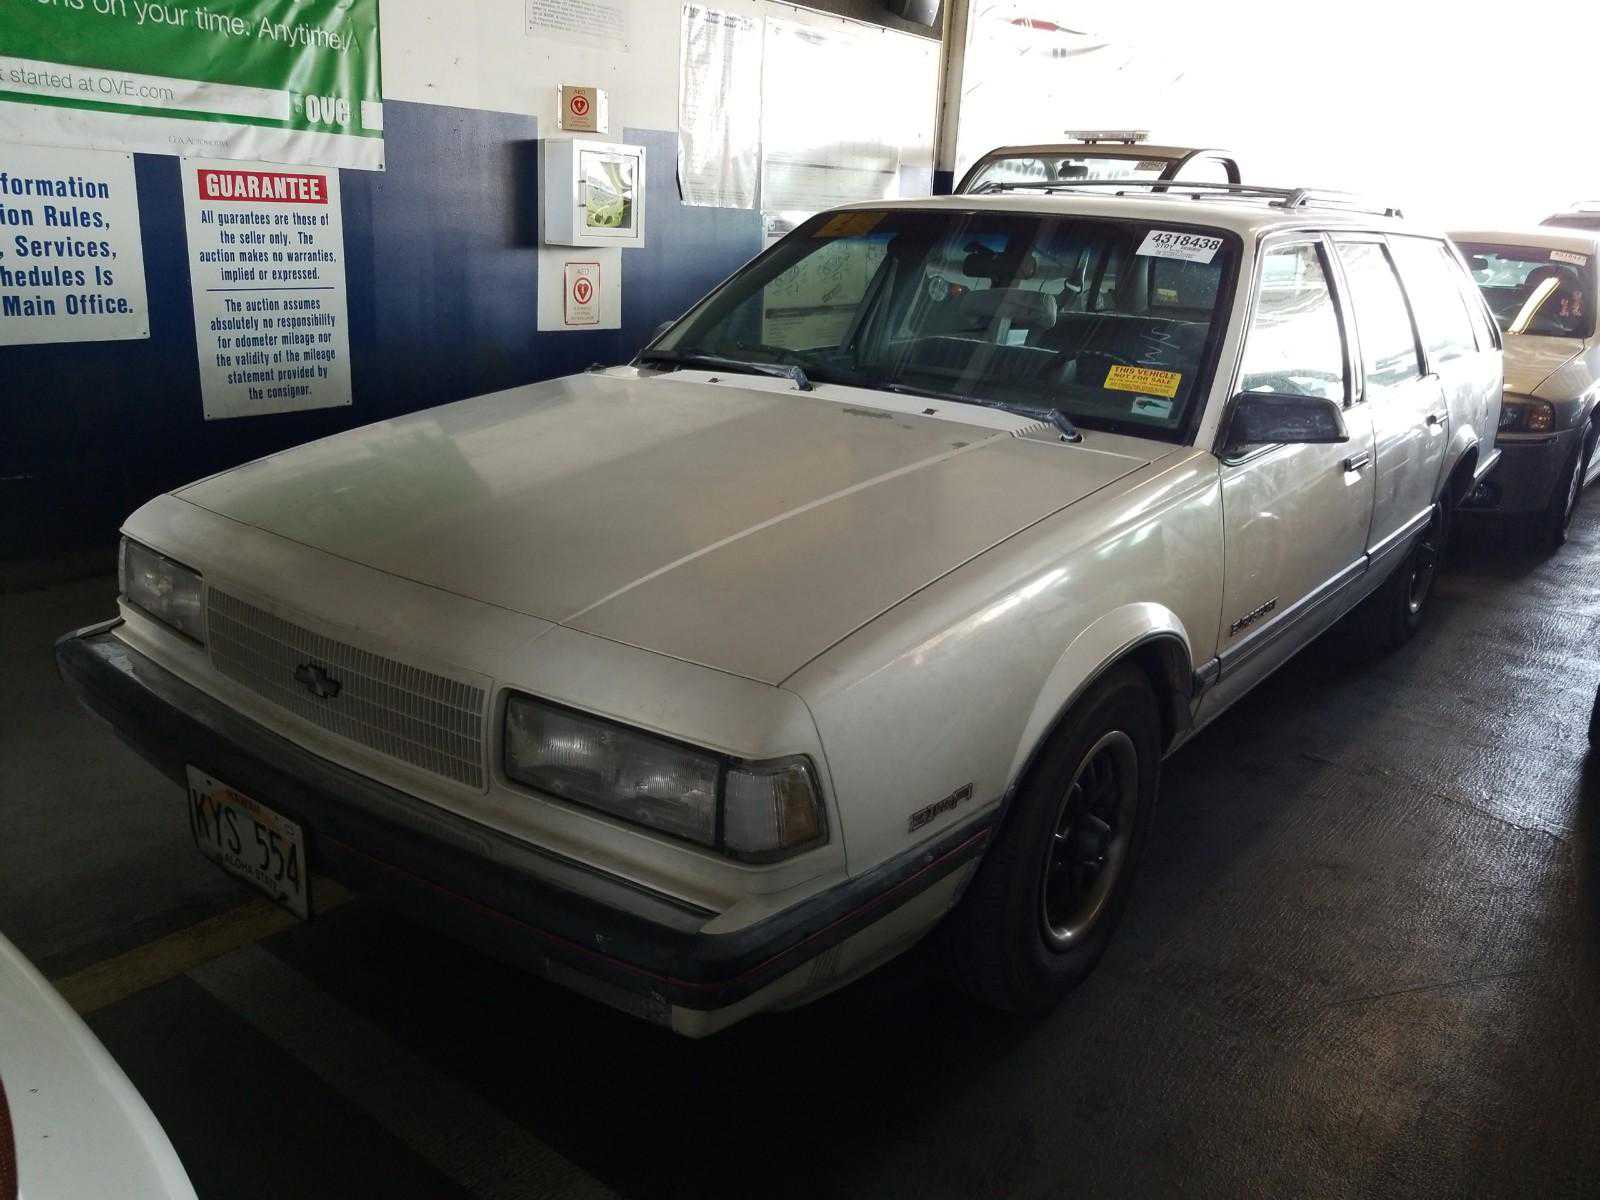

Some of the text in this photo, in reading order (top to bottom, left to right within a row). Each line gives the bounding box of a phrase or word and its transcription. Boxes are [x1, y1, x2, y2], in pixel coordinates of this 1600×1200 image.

[134, 1, 188, 25] your
[196, 7, 250, 36] time.
[10, 68, 73, 89] started
[78, 77, 94, 92] at
[99, 77, 174, 100] OVE.com
[206, 173, 321, 200] GUARANTEE
[44, 205, 110, 231] Rules,
[201, 210, 329, 226] All guarantees are those of
[15, 235, 117, 261] Services,
[220, 231, 314, 248] the seller only. The
[1152, 233, 1219, 250] 4318438
[199, 249, 337, 264] auction makes no warranties,
[95, 265, 113, 286] Is
[220, 267, 320, 283] implied or expressed.
[2, 294, 134, 317] Main Office.
[225, 299, 321, 312] The auction assumes
[210, 314, 336, 332] absolutely no responsibility
[217, 332, 332, 349] for odometer mileage nor
[216, 347, 336, 367] the validity of the mileage
[227, 365, 328, 384] statement provided by
[249, 384, 312, 400] the consignor.
[192, 787, 300, 894] KYS 554
